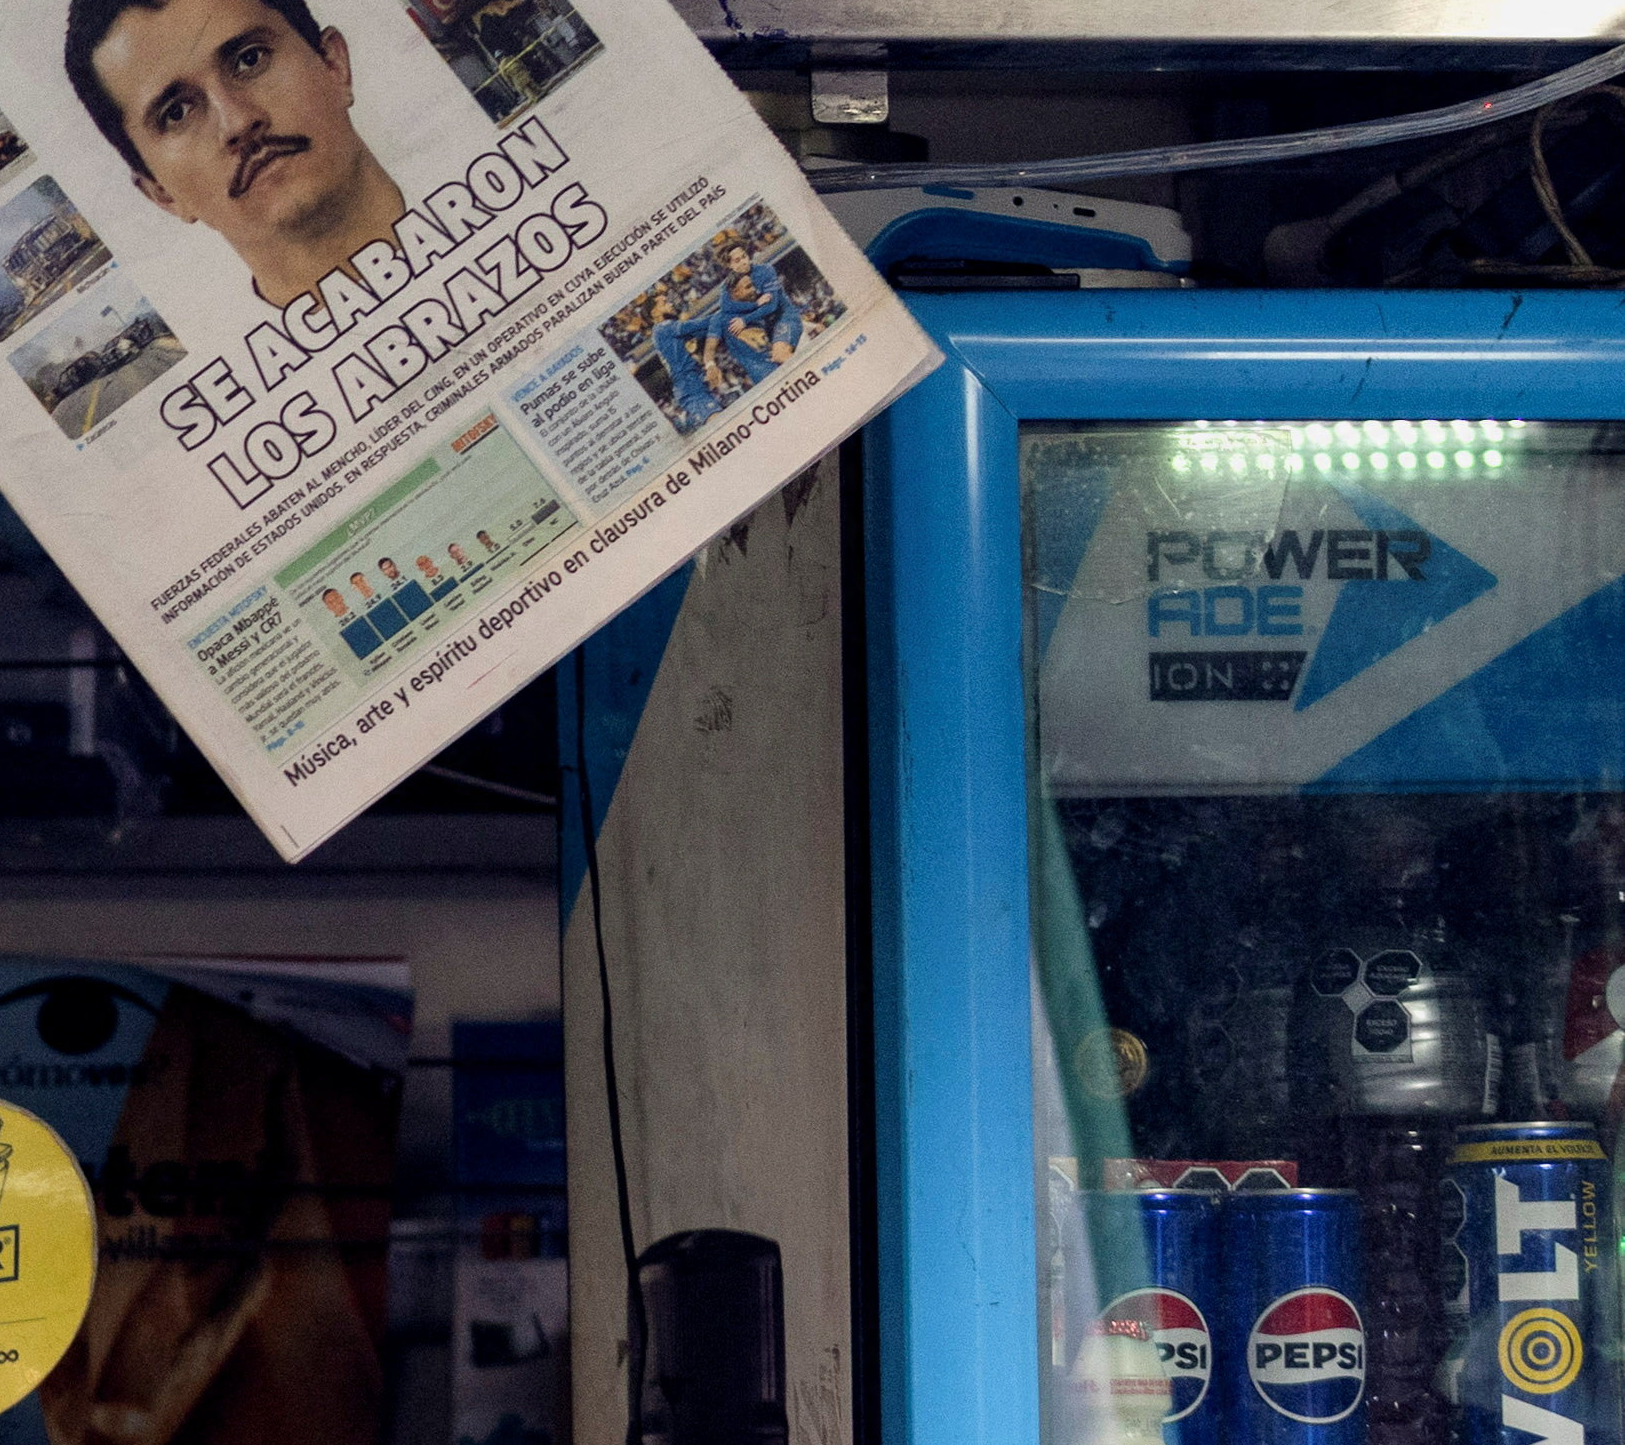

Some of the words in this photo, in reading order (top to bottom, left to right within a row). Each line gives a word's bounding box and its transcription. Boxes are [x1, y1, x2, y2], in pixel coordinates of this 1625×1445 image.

[160, 356, 256, 452] SE
[244, 115, 570, 391] ACABARON
[207, 390, 337, 510] LOS
[331, 181, 608, 423] ABRAZOS
[284, 734, 357, 786] Música,
[357, 701, 394, 733] arte
[394, 688, 411, 708] y
[410, 636, 477, 692] espíritu
[479, 571, 562, 639] deportivo
[564, 551, 589, 573] en
[590, 492, 666, 553] clausura
[664, 470, 691, 495] de
[688, 371, 820, 475] Milano-Cortina
[1147, 530, 1431, 581] POWER
[1154, 663, 1233, 690] ION
[1582, 1182, 1601, 1275] YELLOW
[1255, 1341, 1365, 1371] PEPSI
